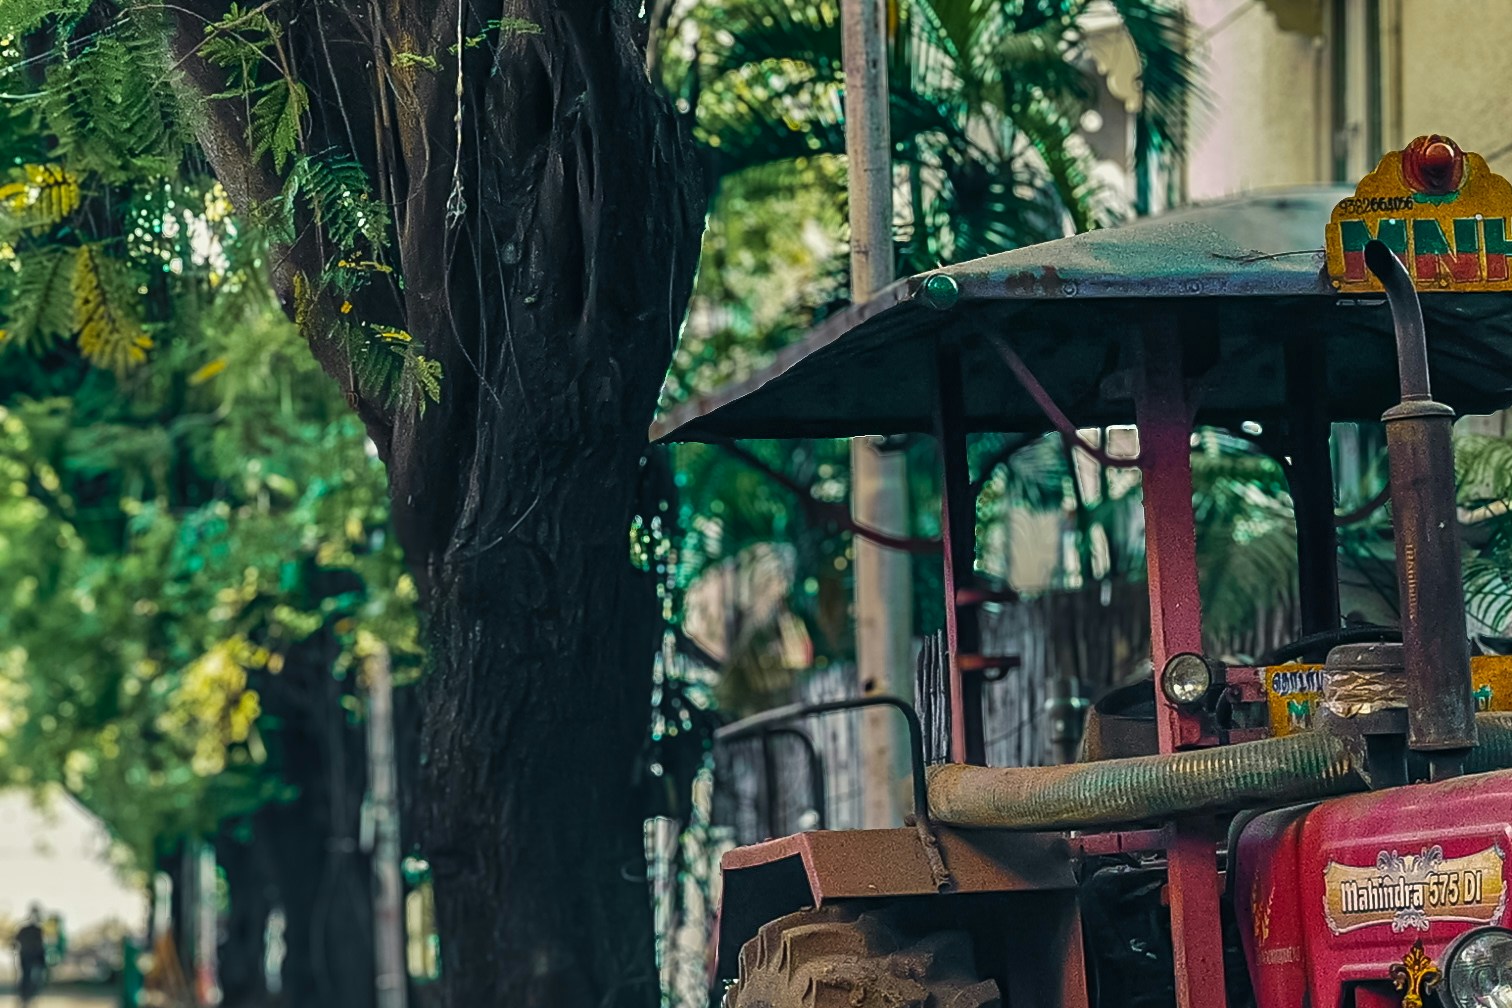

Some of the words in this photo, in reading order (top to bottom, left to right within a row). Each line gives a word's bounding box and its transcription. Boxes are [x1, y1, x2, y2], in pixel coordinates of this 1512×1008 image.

[1341, 877, 1424, 914] Mahindra
[1428, 871, 1460, 906] 575
[1463, 870, 1483, 904] DI
